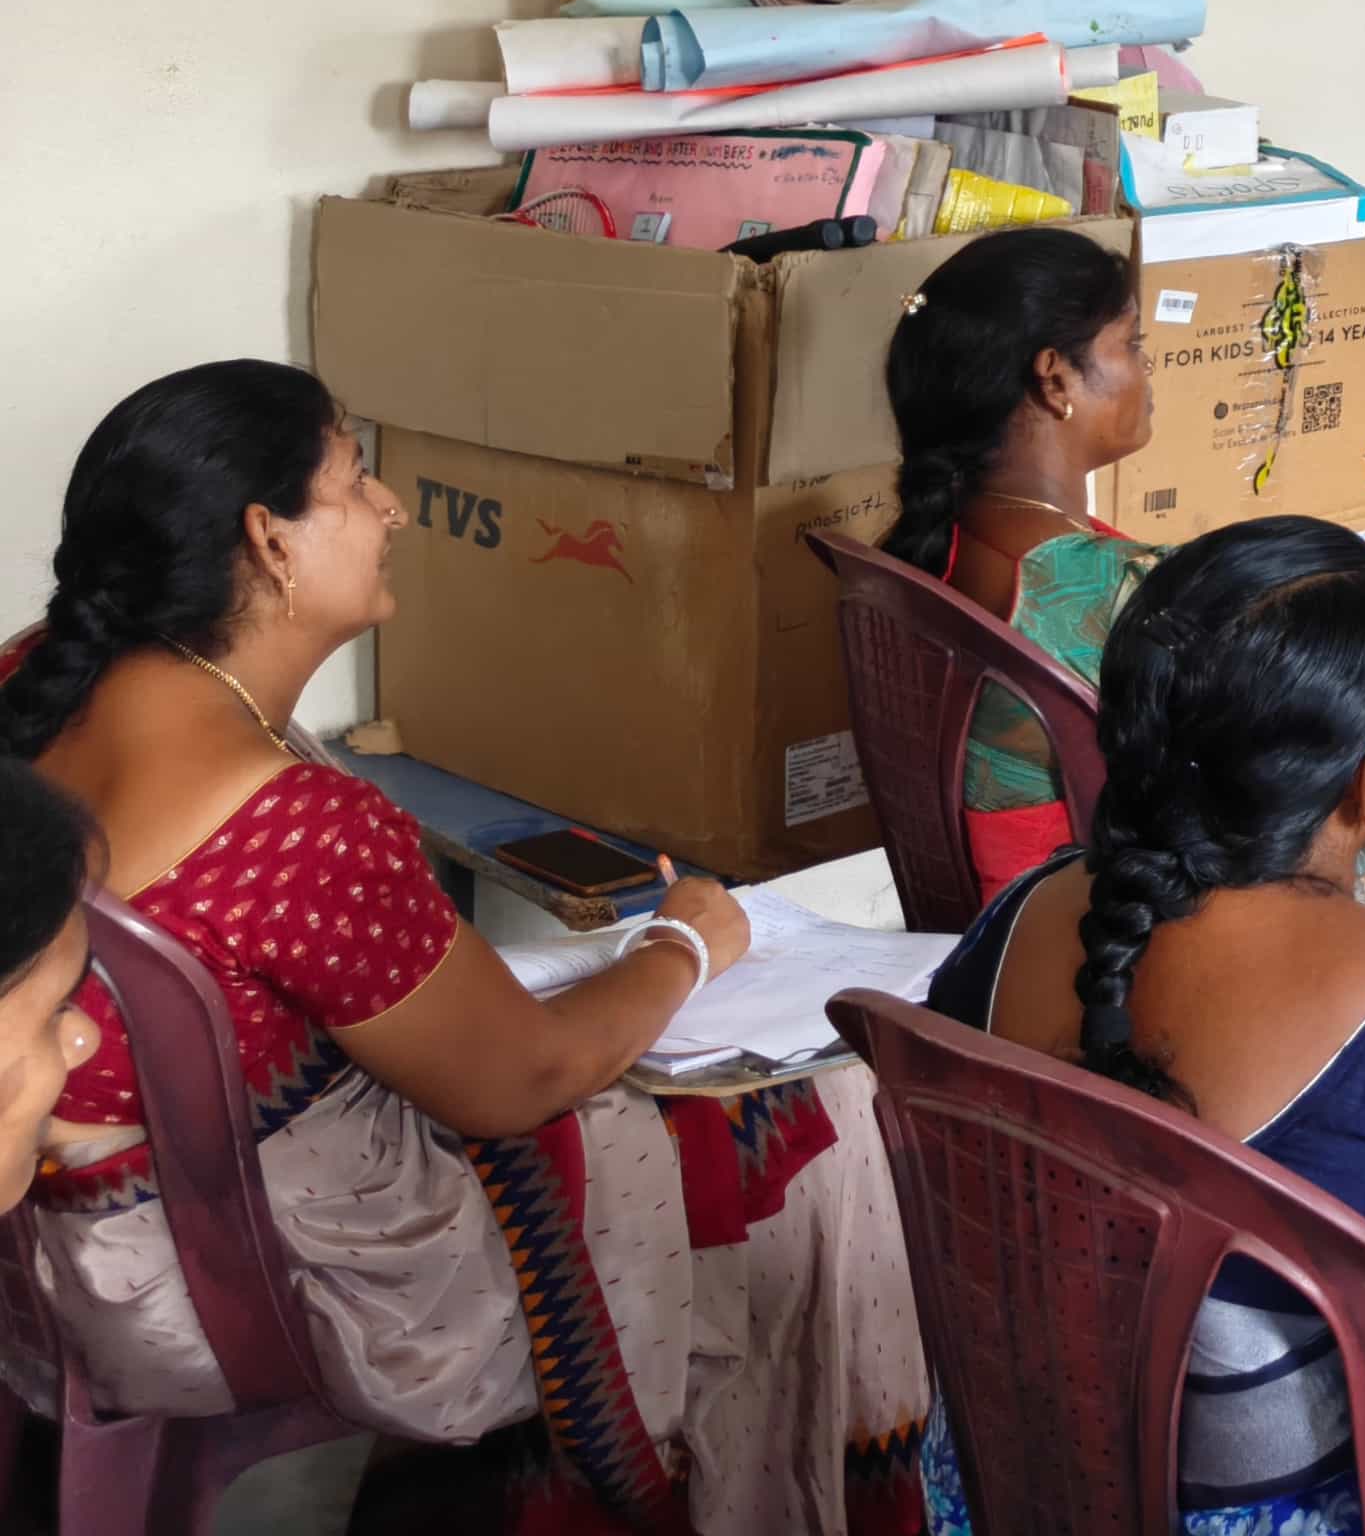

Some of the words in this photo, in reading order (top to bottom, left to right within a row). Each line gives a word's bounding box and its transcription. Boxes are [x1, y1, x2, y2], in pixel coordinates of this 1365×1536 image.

[1164, 349, 1204, 369] FOR
[1210, 340, 1254, 361] KIDS
[1318, 329, 1335, 345] 14
[1196, 323, 1245, 338] LARGEST
[416, 474, 503, 550] TVS
